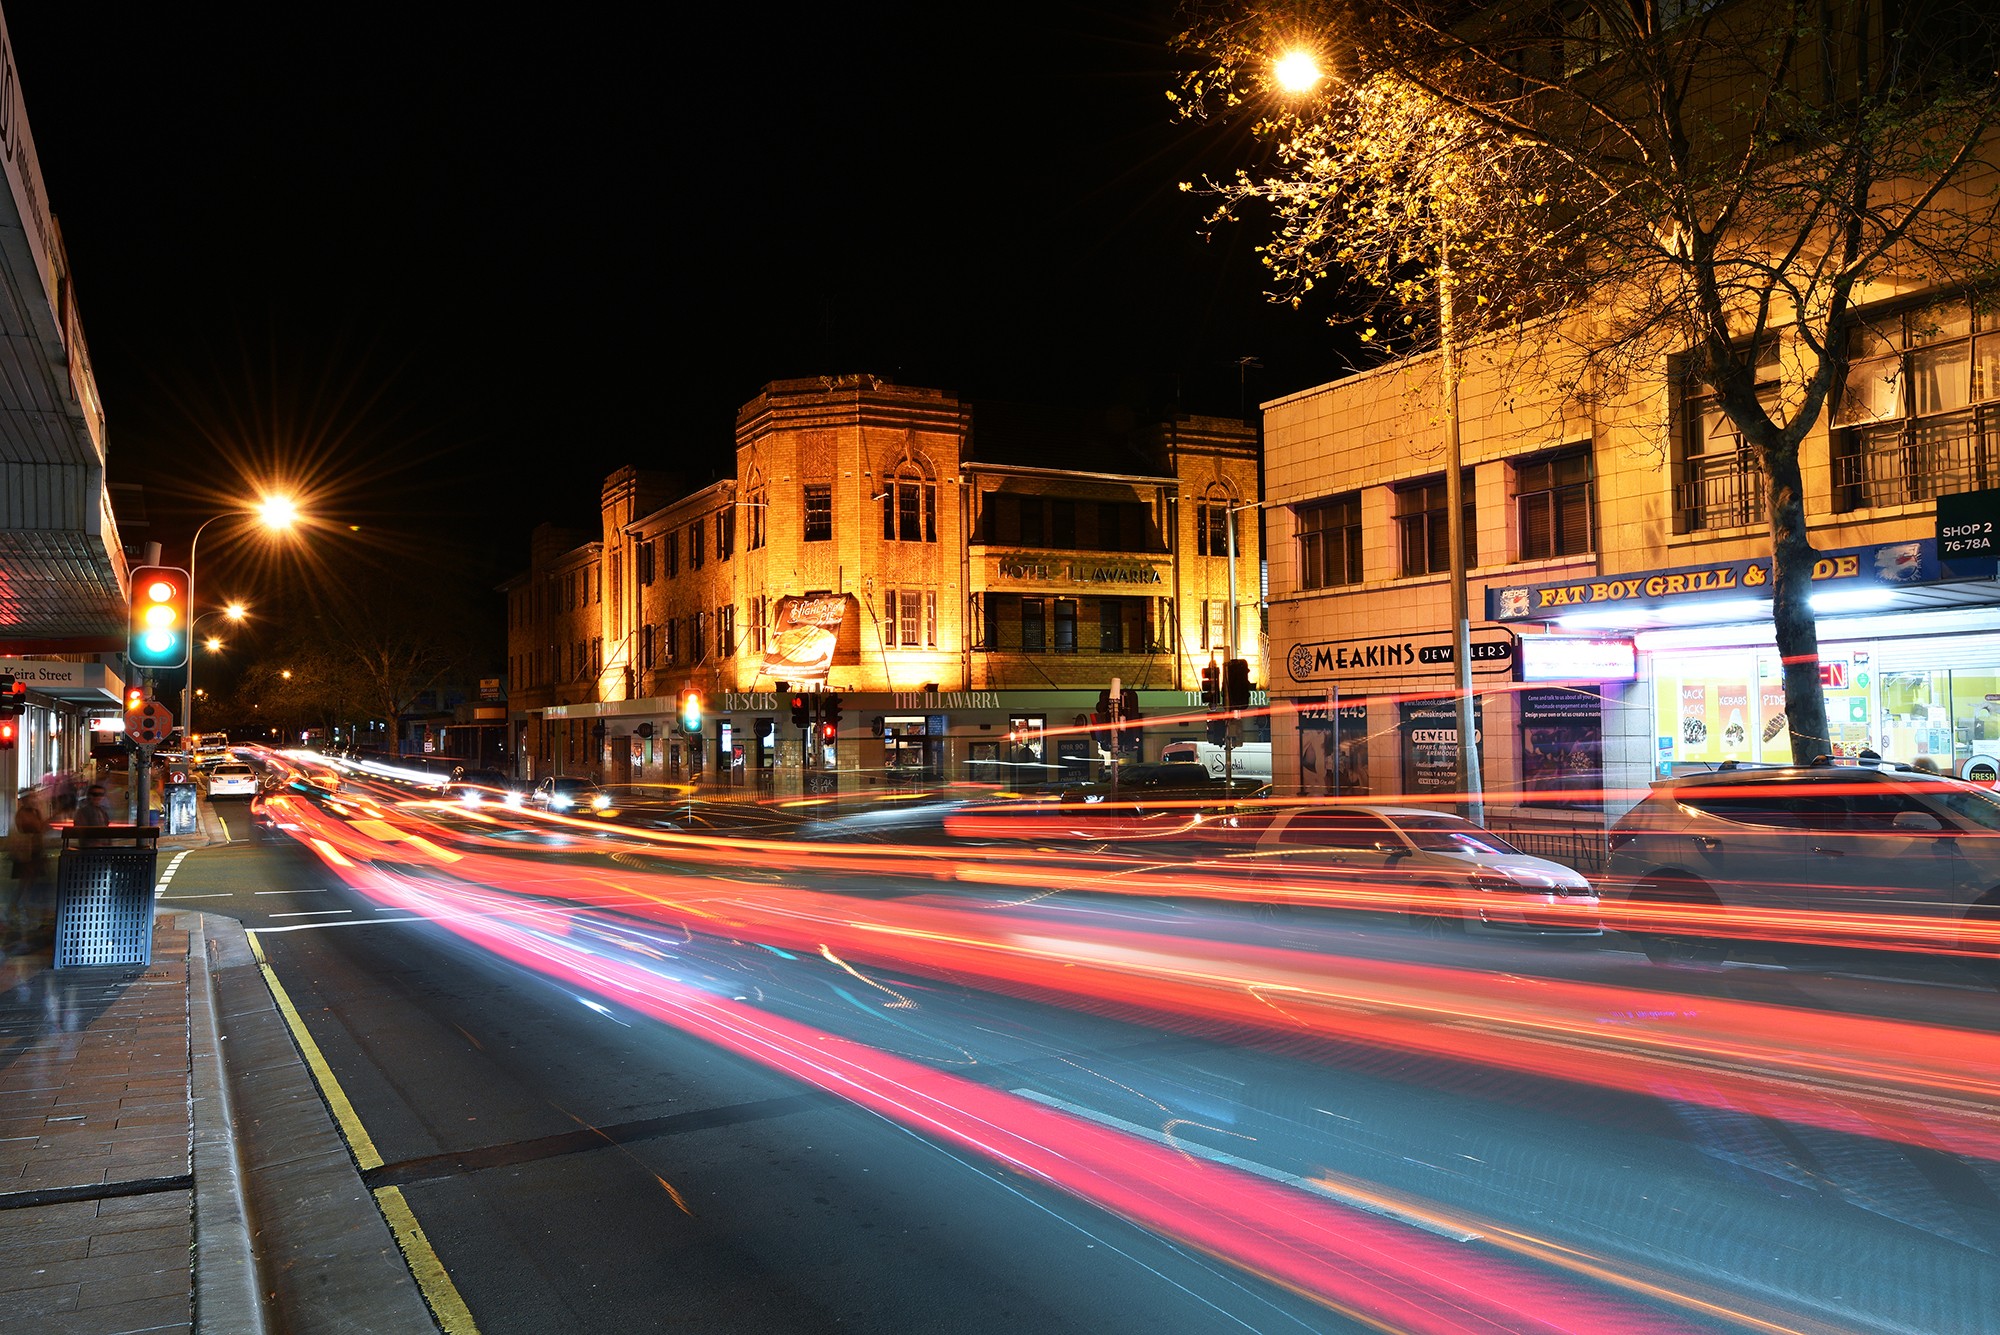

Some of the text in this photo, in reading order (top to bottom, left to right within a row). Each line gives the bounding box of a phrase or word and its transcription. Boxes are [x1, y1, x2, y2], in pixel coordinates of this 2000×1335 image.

[1942, 522, 1993, 538] SHOP 2
[1944, 537, 1991, 552] 76-78A
[997, 563, 1162, 585] HOTEL ILLAWARRA
[1502, 587, 1528, 599] PEPSI
[1536, 586, 1586, 609] FAT
[1588, 580, 1645, 603] BOY
[1645, 569, 1740, 598] GRILL
[1742, 564, 1768, 586] &
[790, 602, 838, 619] HIGHLAND
[1314, 643, 1415, 672] MEAKINS
[1424, 645, 1506, 660] JEWLERS
[39, 667, 72, 681] Street
[1819, 664, 1845, 688] EN
[725, 692, 778, 710] RESCHS
[892, 692, 1000, 709] THE ILLAWARRA
[1681, 689, 1704, 699] NACK
[1719, 696, 1747, 706] KEBABS
[1762, 694, 1785, 706] PIDE
[1682, 704, 1704, 715] ACKS
[129, 715, 169, 731] STOP
[1414, 731, 1478, 741] JEWELLY
[1971, 773, 1995, 781] FRESH
